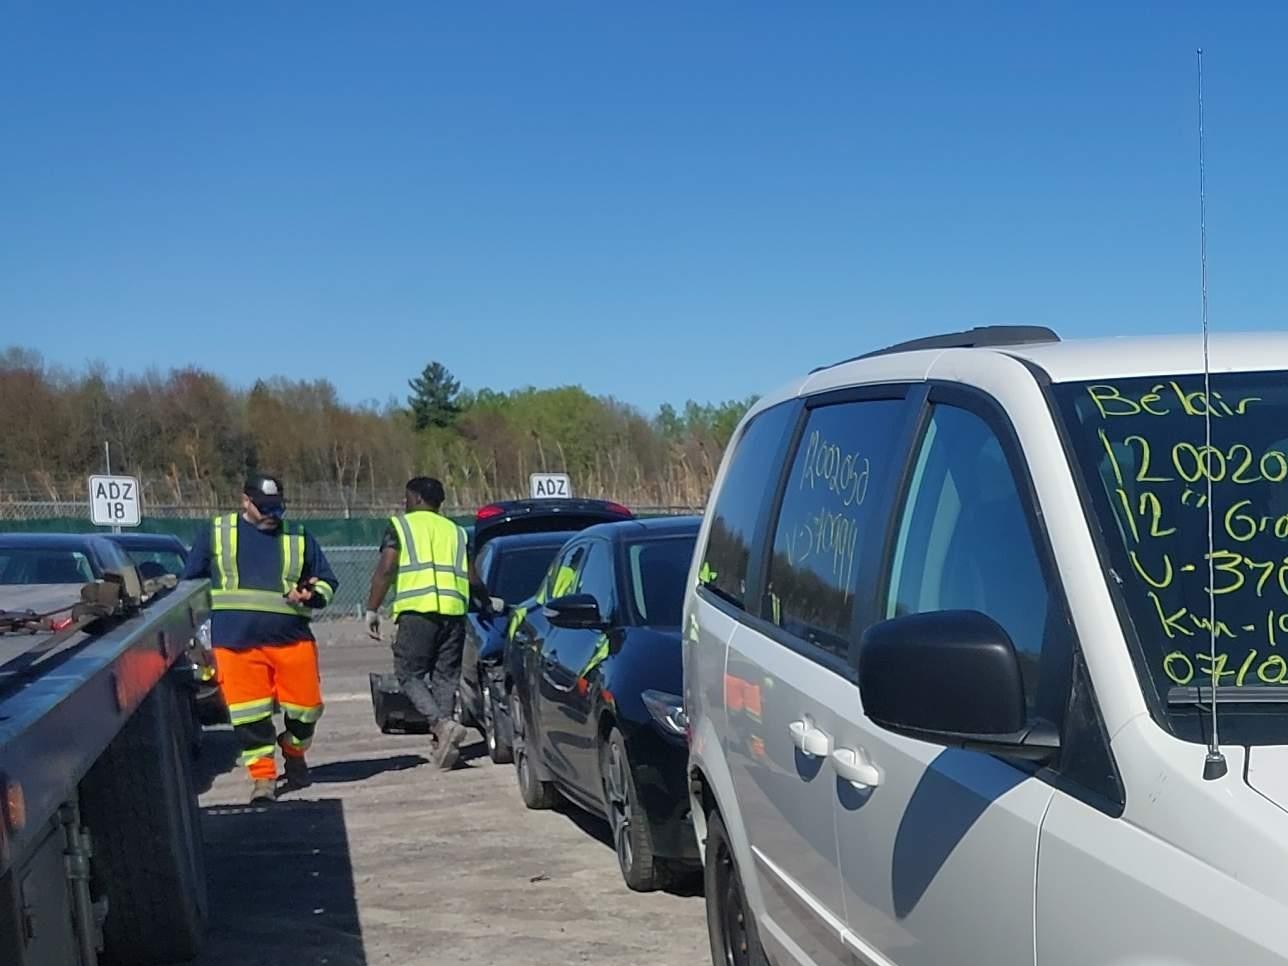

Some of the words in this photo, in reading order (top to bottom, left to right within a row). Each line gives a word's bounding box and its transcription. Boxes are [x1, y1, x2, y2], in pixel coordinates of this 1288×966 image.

[96, 482, 134, 500] ADZ
[536, 480, 567, 496] ADZ
[107, 502, 125, 519] 18
